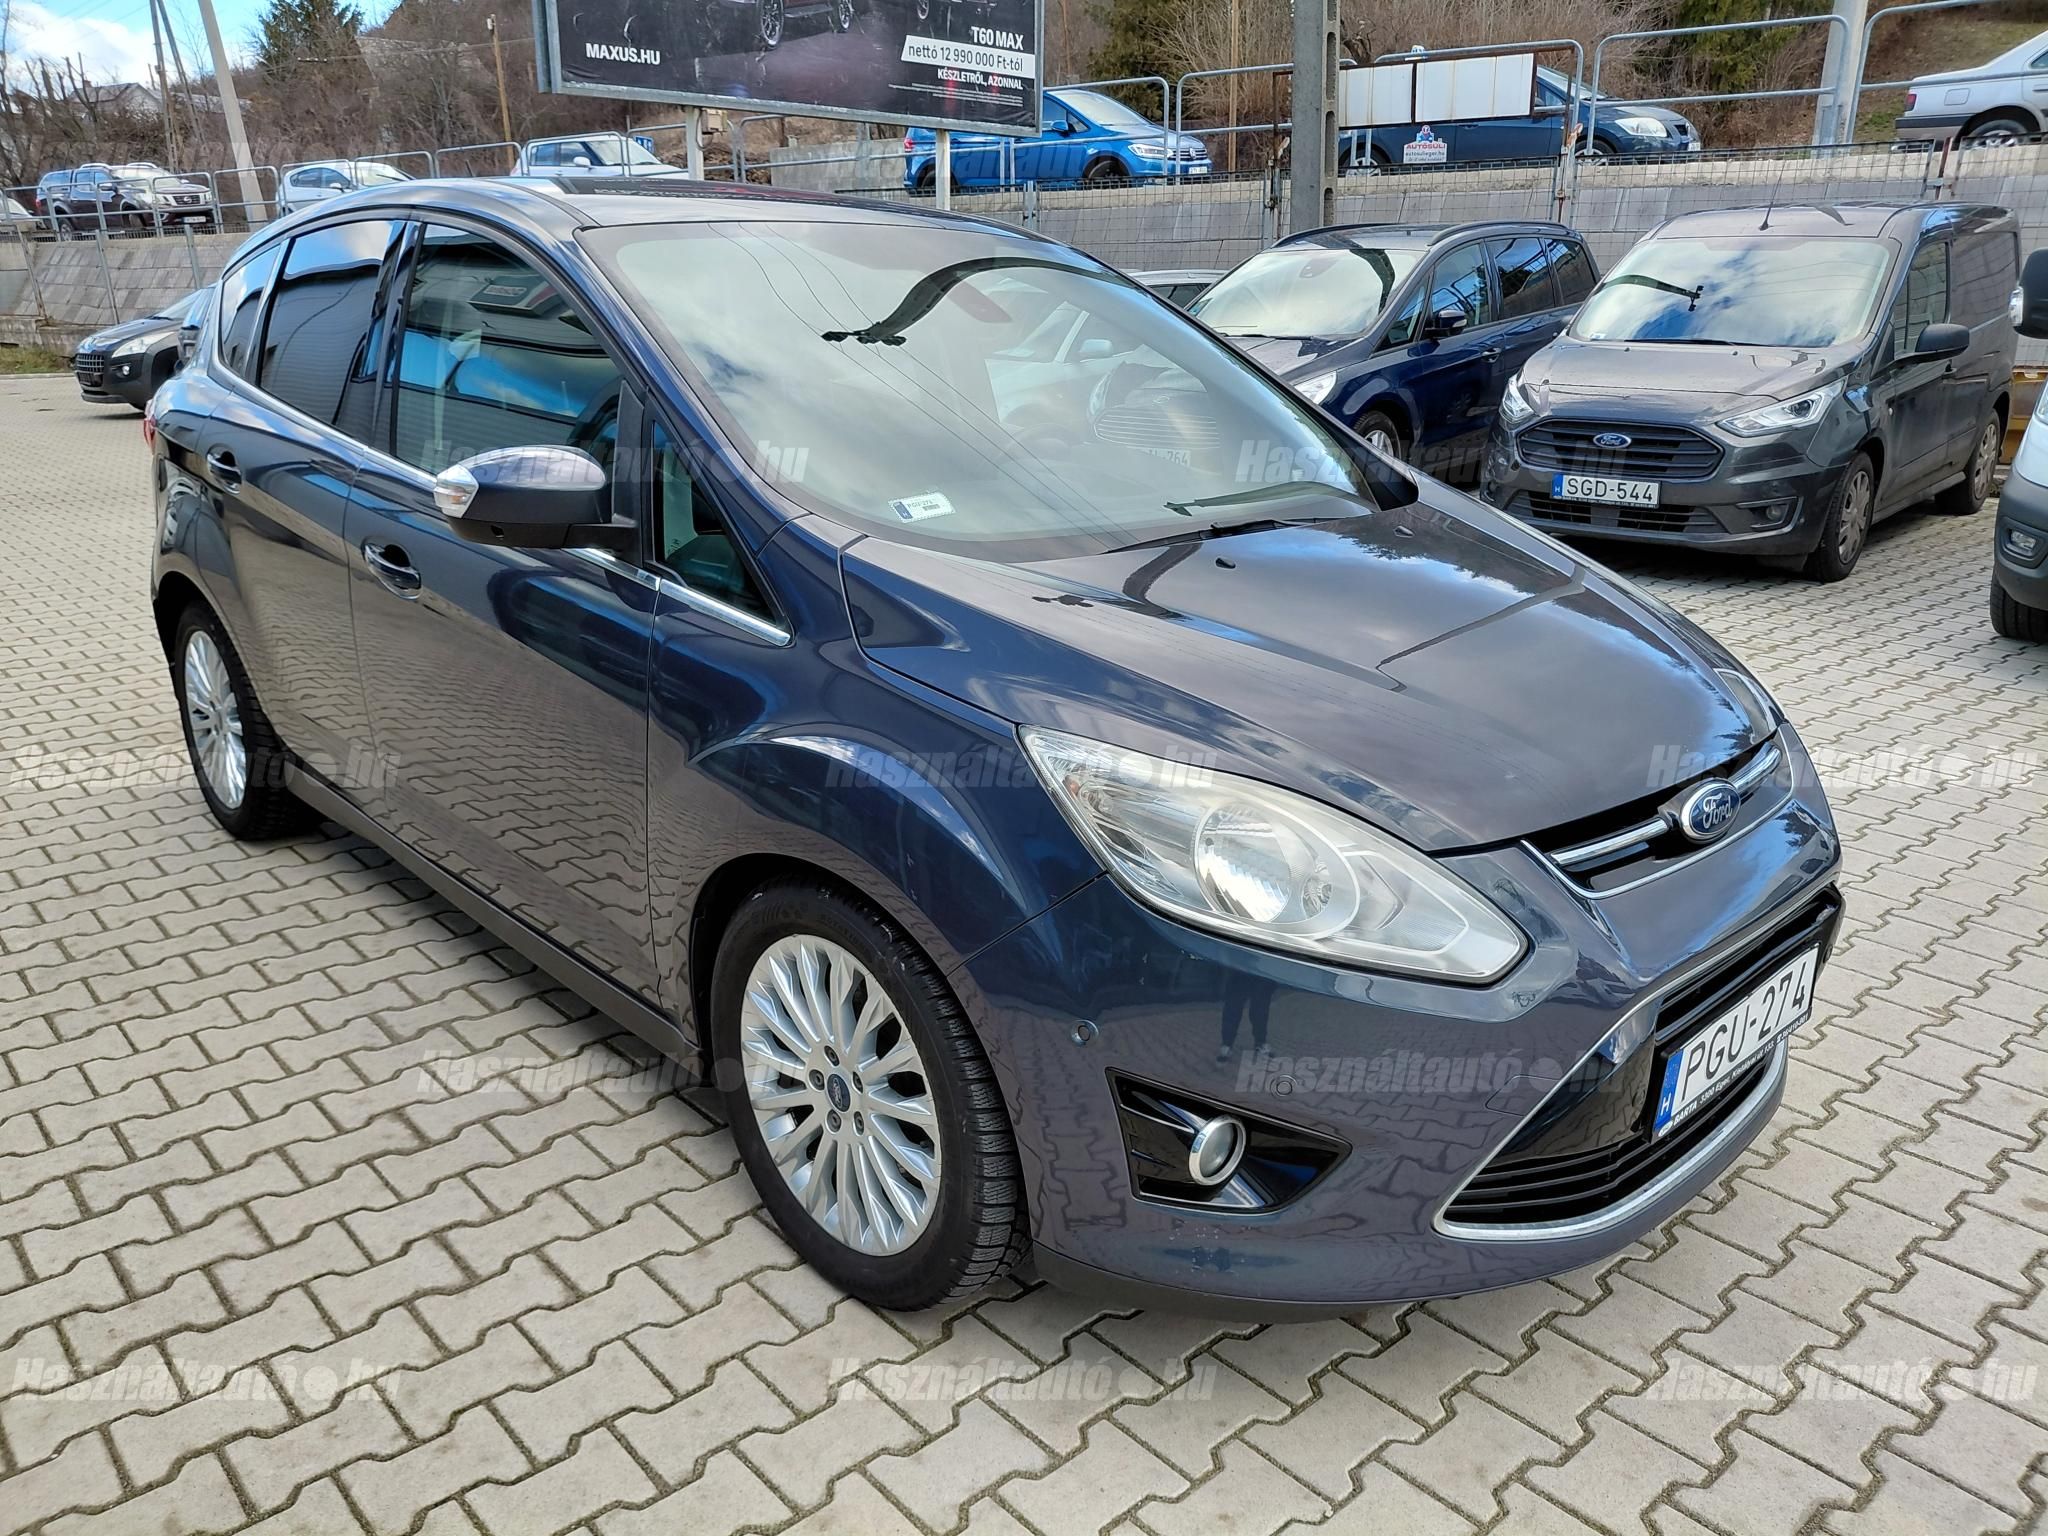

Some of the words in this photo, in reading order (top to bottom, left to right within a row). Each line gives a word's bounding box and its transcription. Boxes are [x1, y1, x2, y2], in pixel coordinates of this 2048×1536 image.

[971, 26, 993, 46] T60
[996, 30, 1024, 50] MAX
[585, 42, 661, 65] MAXUS.HU
[908, 44, 938, 60] nettó
[940, 47, 951, 61] 12
[953, 49, 973, 64] 990
[975, 52, 995, 67] 000
[996, 55, 1023, 72] Ft-tól
[937, 67, 988, 87] KÉSZLETRŐL,
[987, 76, 1024, 90] AZONNAL
[1600, 434, 1623, 446] Ford
[1566, 478, 1653, 502] SGD-544
[1703, 792, 1733, 829] Ford
[1660, 1093, 1672, 1116] H
[1682, 960, 1807, 1102] PGU-274
